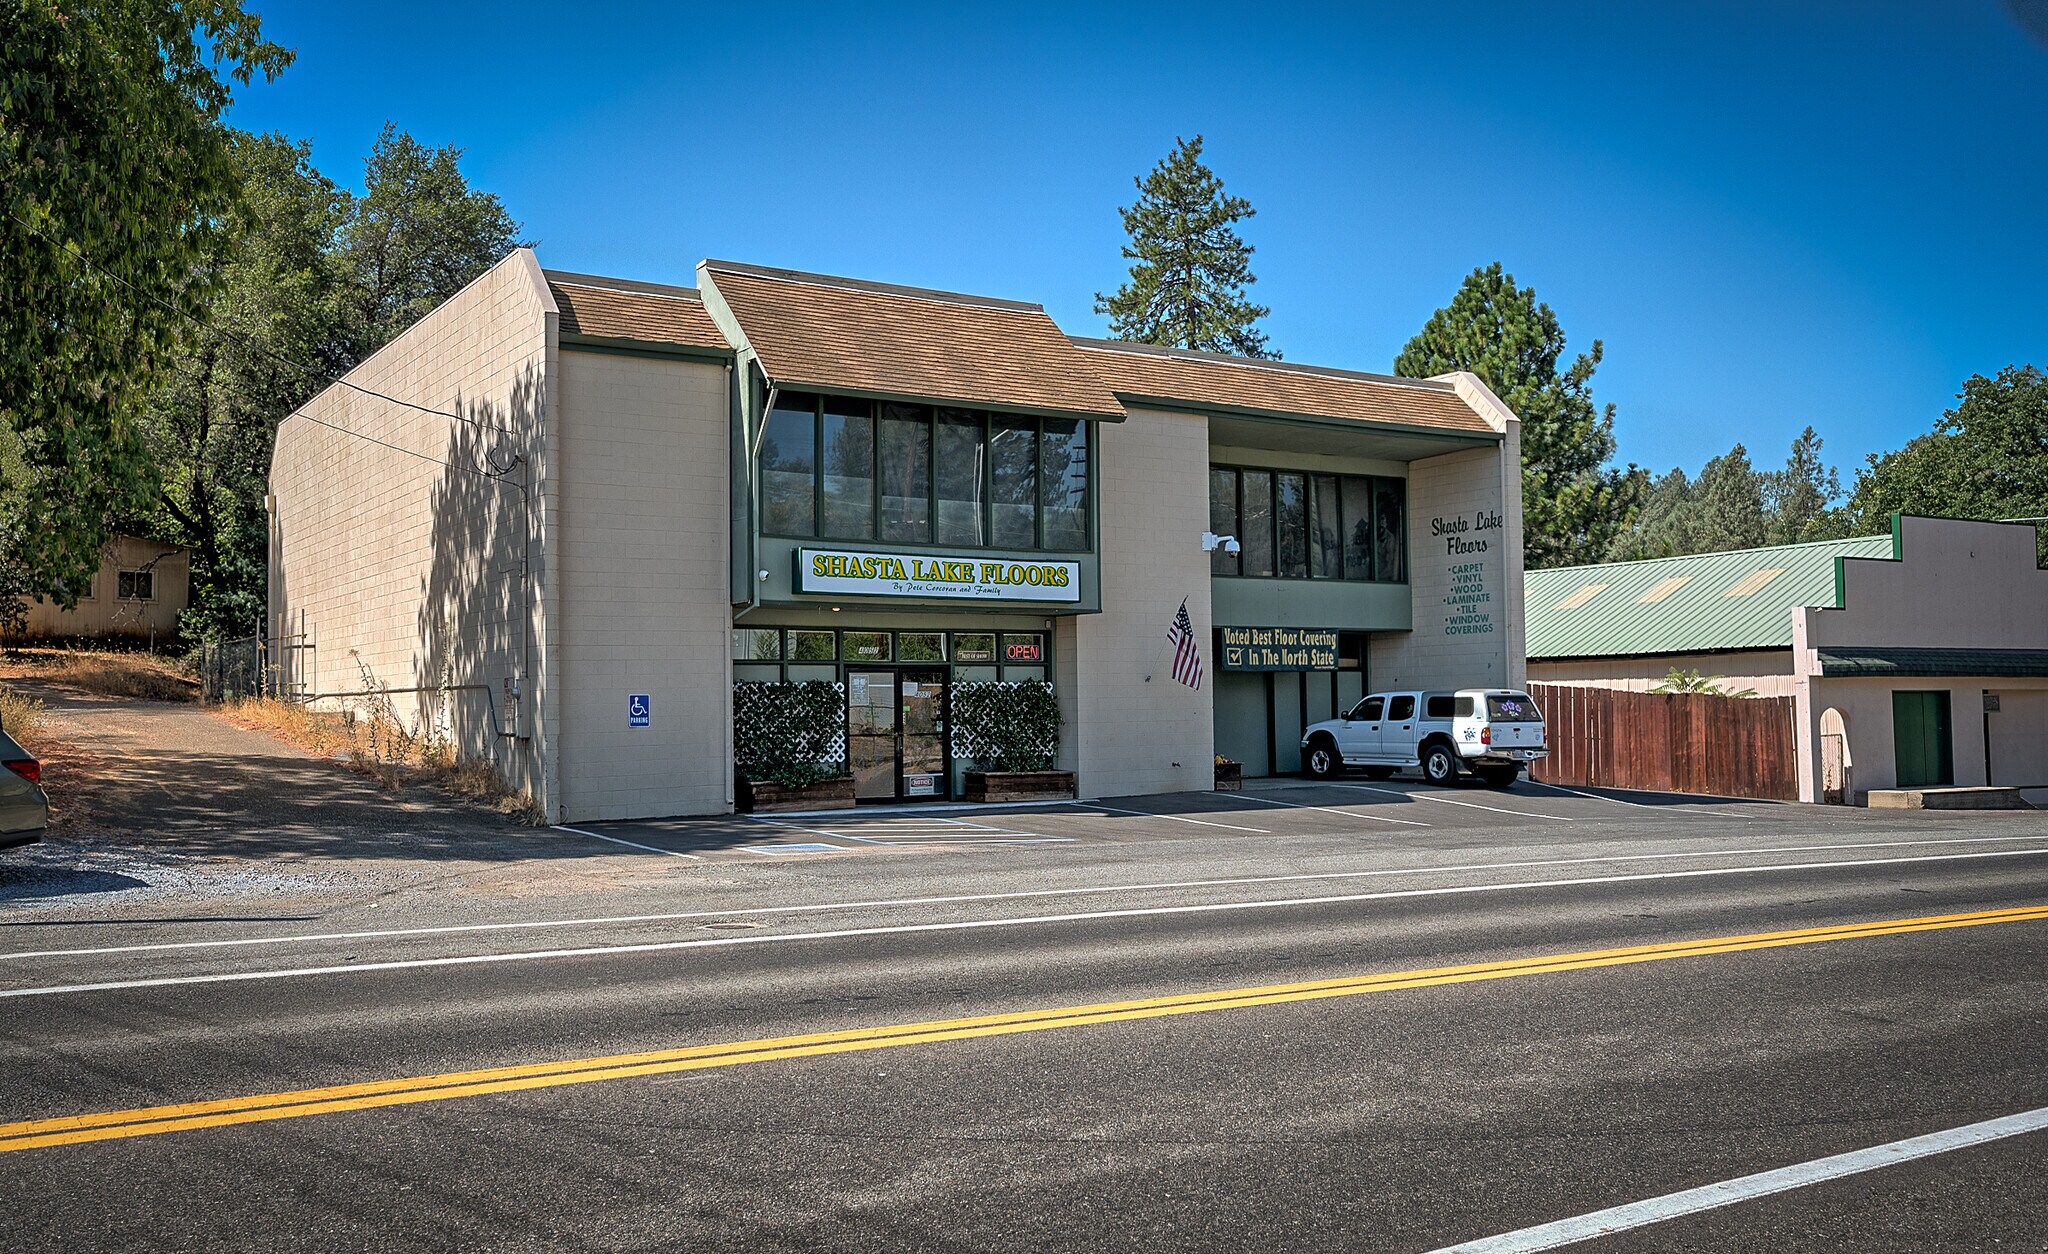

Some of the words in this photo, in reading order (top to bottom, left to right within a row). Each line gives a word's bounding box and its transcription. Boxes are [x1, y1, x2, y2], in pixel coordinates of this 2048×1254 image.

[1431, 516, 1469, 537] Shasta
[1474, 510, 1503, 531] Lake
[1446, 536, 1488, 555] Floors
[812, 555, 907, 581] SHASTA
[912, 559, 975, 584] LAKE
[981, 564, 1070, 587] FLOORS
[1452, 563, 1483, 574] CARPET
[1456, 573, 1483, 583] VINYL
[892, 582, 903, 592] By
[959, 585, 971, 593] and
[973, 585, 1002, 596] Family
[1454, 584, 1483, 594] WOOD
[1447, 593, 1490, 605] LAMINATE
[1461, 605, 1477, 614] TILE
[1449, 614, 1490, 625] WINDOW
[1445, 624, 1493, 636] COVERINGS
[1224, 628, 1250, 645] Voted
[1252, 629, 1272, 645] Best
[1274, 629, 1297, 646] Floor
[1300, 630, 1337, 649] Covering
[1008, 645, 1038, 659] OPEN
[1249, 649, 1259, 665] In
[1262, 649, 1279, 665] The
[1282, 649, 1309, 666] North
[1311, 649, 1334, 666] State
